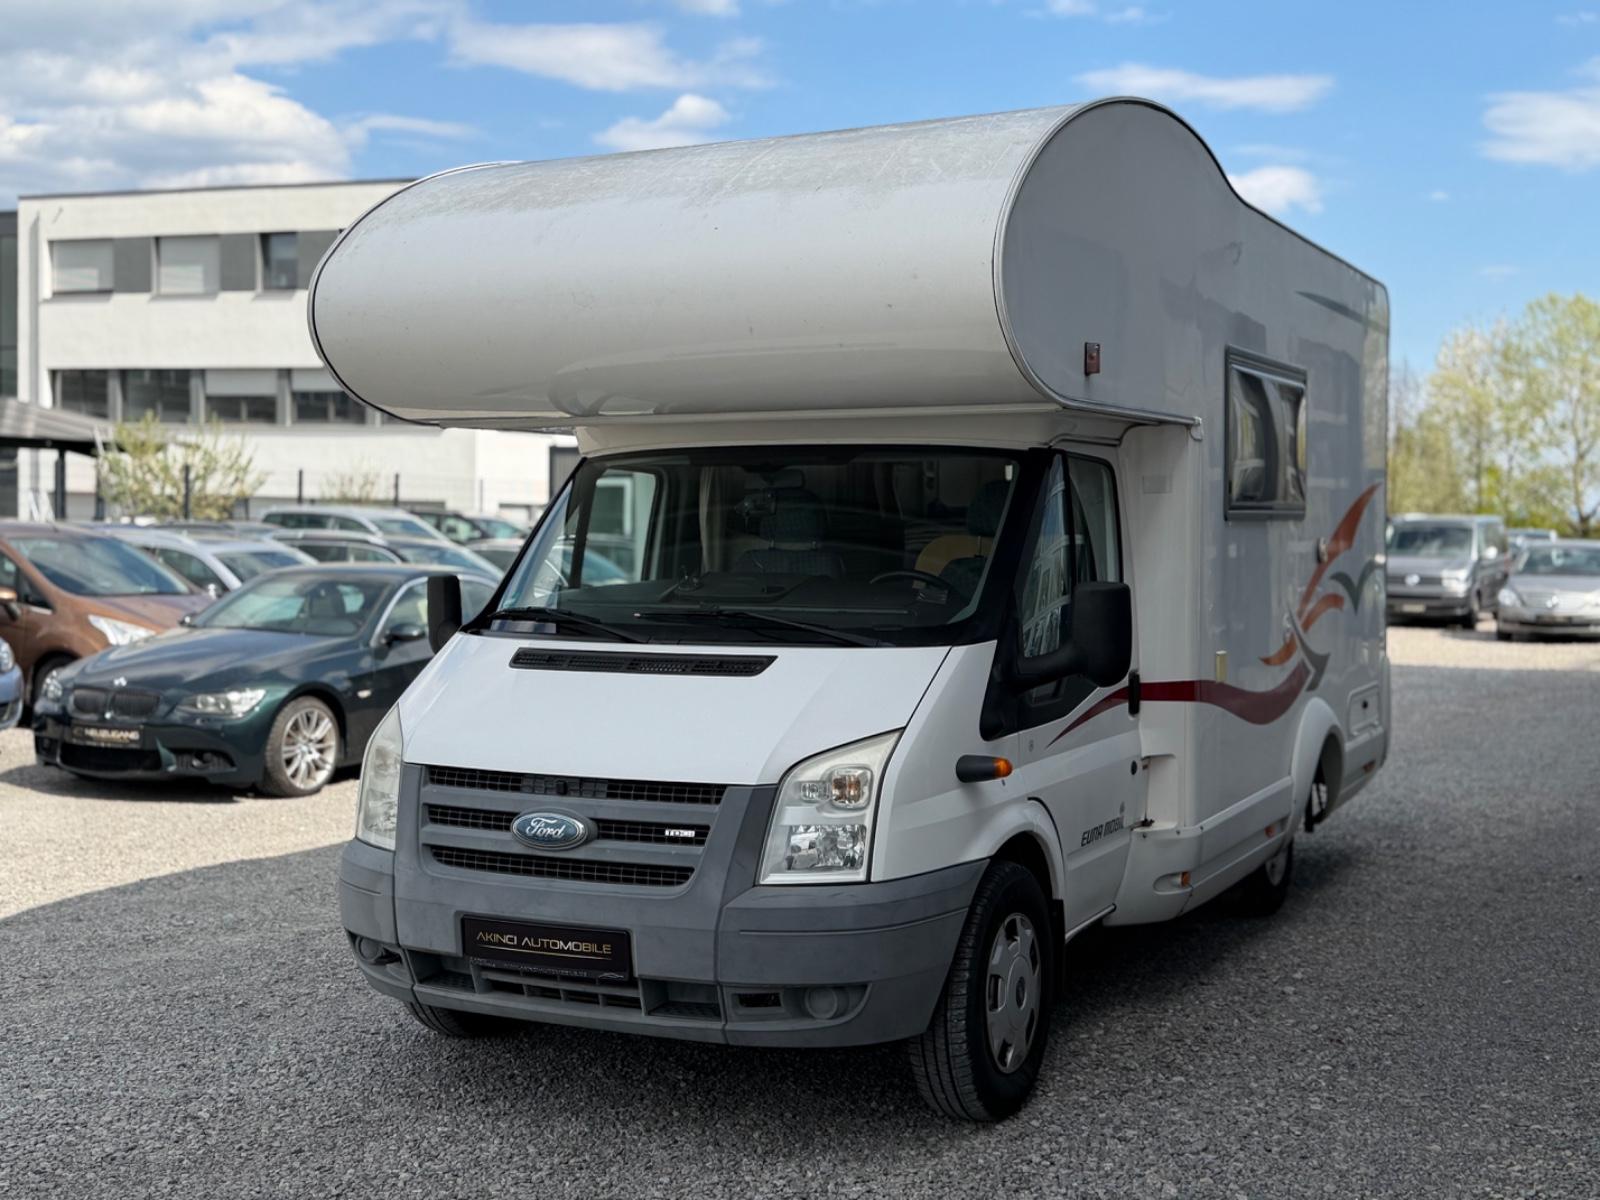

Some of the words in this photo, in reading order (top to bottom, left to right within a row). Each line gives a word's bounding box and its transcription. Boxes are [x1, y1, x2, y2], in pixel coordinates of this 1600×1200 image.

[525, 817, 567, 839] Ford
[476, 931, 517, 944] AKINCI
[522, 937, 612, 954] AUTOMOBILE
